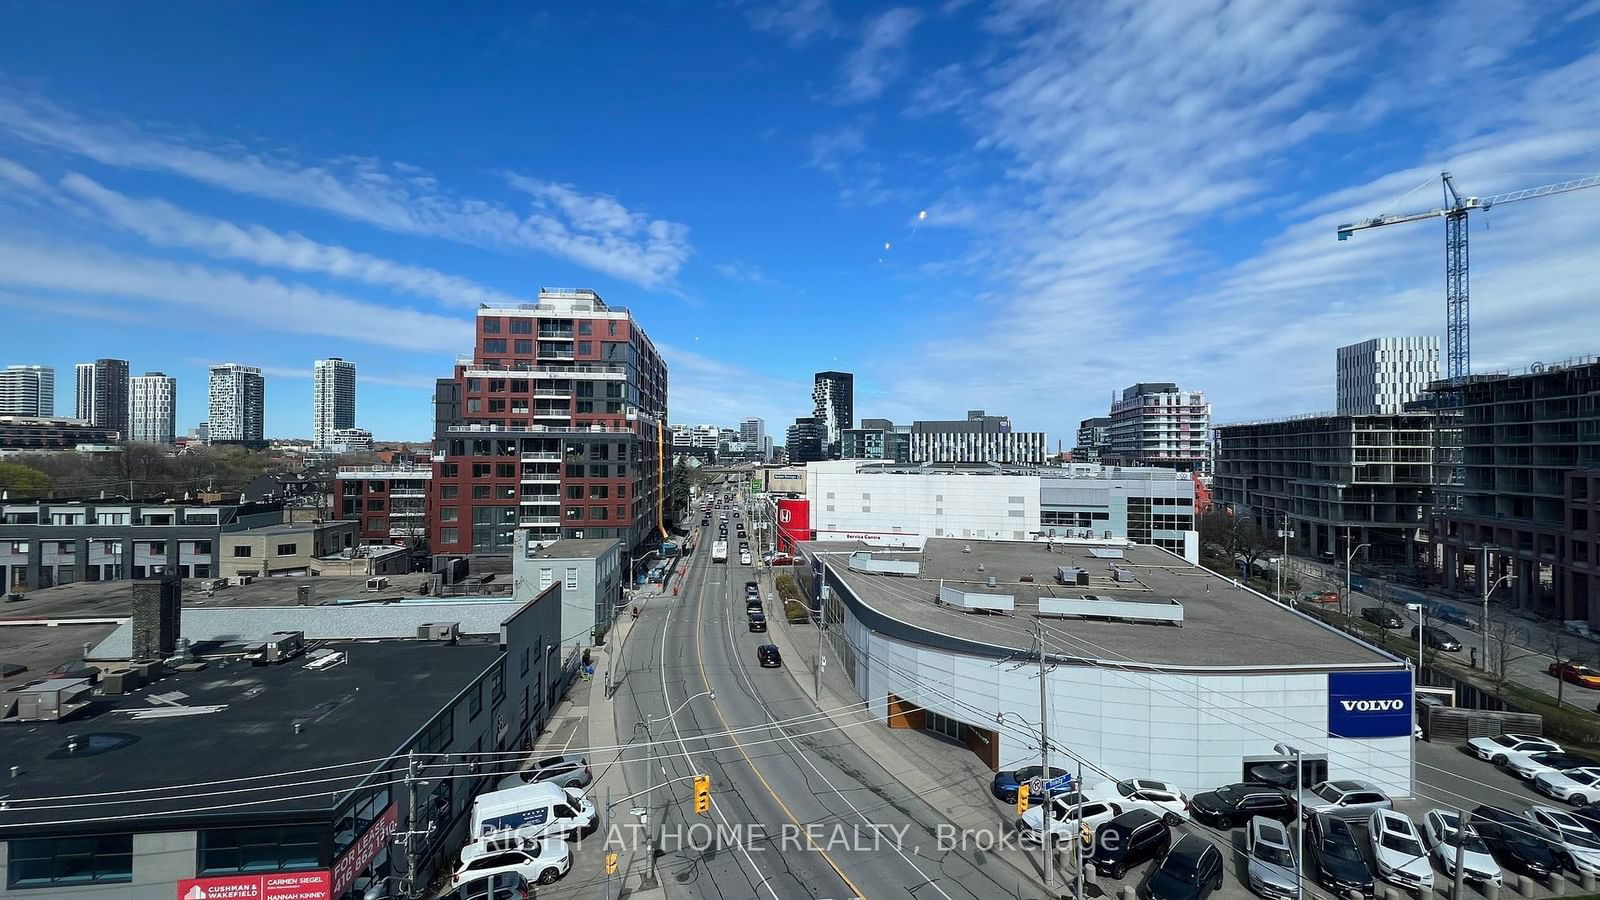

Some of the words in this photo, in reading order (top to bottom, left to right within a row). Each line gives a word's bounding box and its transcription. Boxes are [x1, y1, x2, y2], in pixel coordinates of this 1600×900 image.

[1340, 700, 1404, 711] VOLVO
[334, 850, 355, 880] FOR
[357, 817, 386, 855] LEASE
[333, 866, 353, 893] 416
[355, 845, 374, 871] 862
[208, 890, 258, 898] WAKEFIELD
[300, 891, 325, 899] KINNEY
